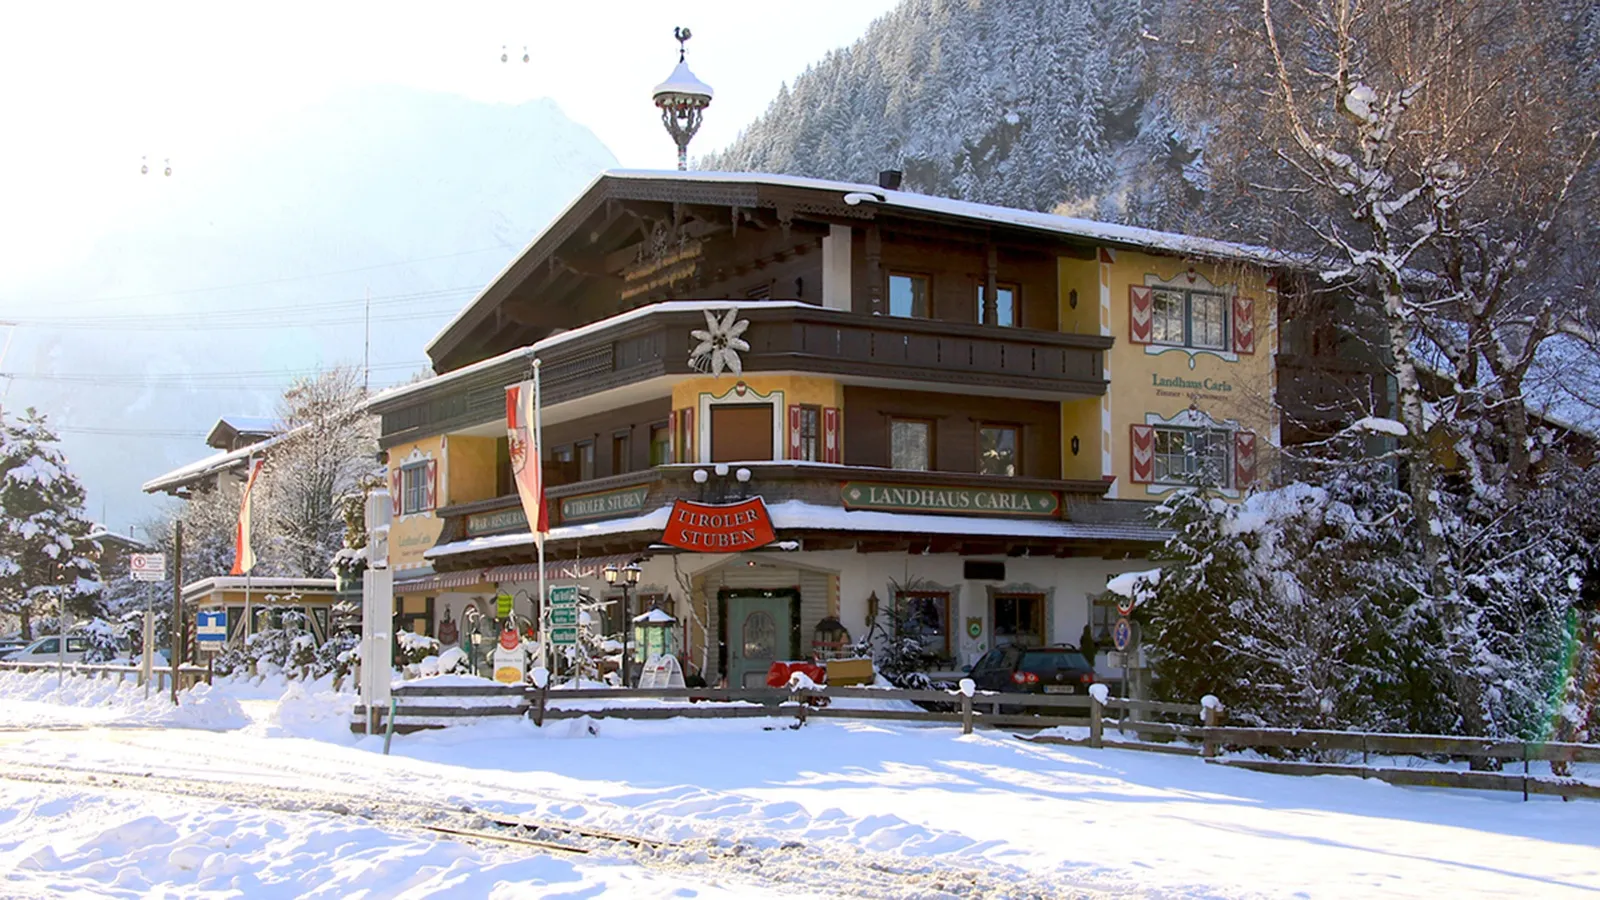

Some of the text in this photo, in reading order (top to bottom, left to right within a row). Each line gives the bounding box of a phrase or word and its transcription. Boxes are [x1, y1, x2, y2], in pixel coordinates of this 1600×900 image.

[1152, 374, 1232, 391] Landhaus Carla
[571, 493, 642, 515] TIROLER STUBEN
[868, 487, 1032, 510] LANDHAUS CARLA
[678, 508, 760, 528] TIROLER
[680, 528, 757, 547] STUBEN
